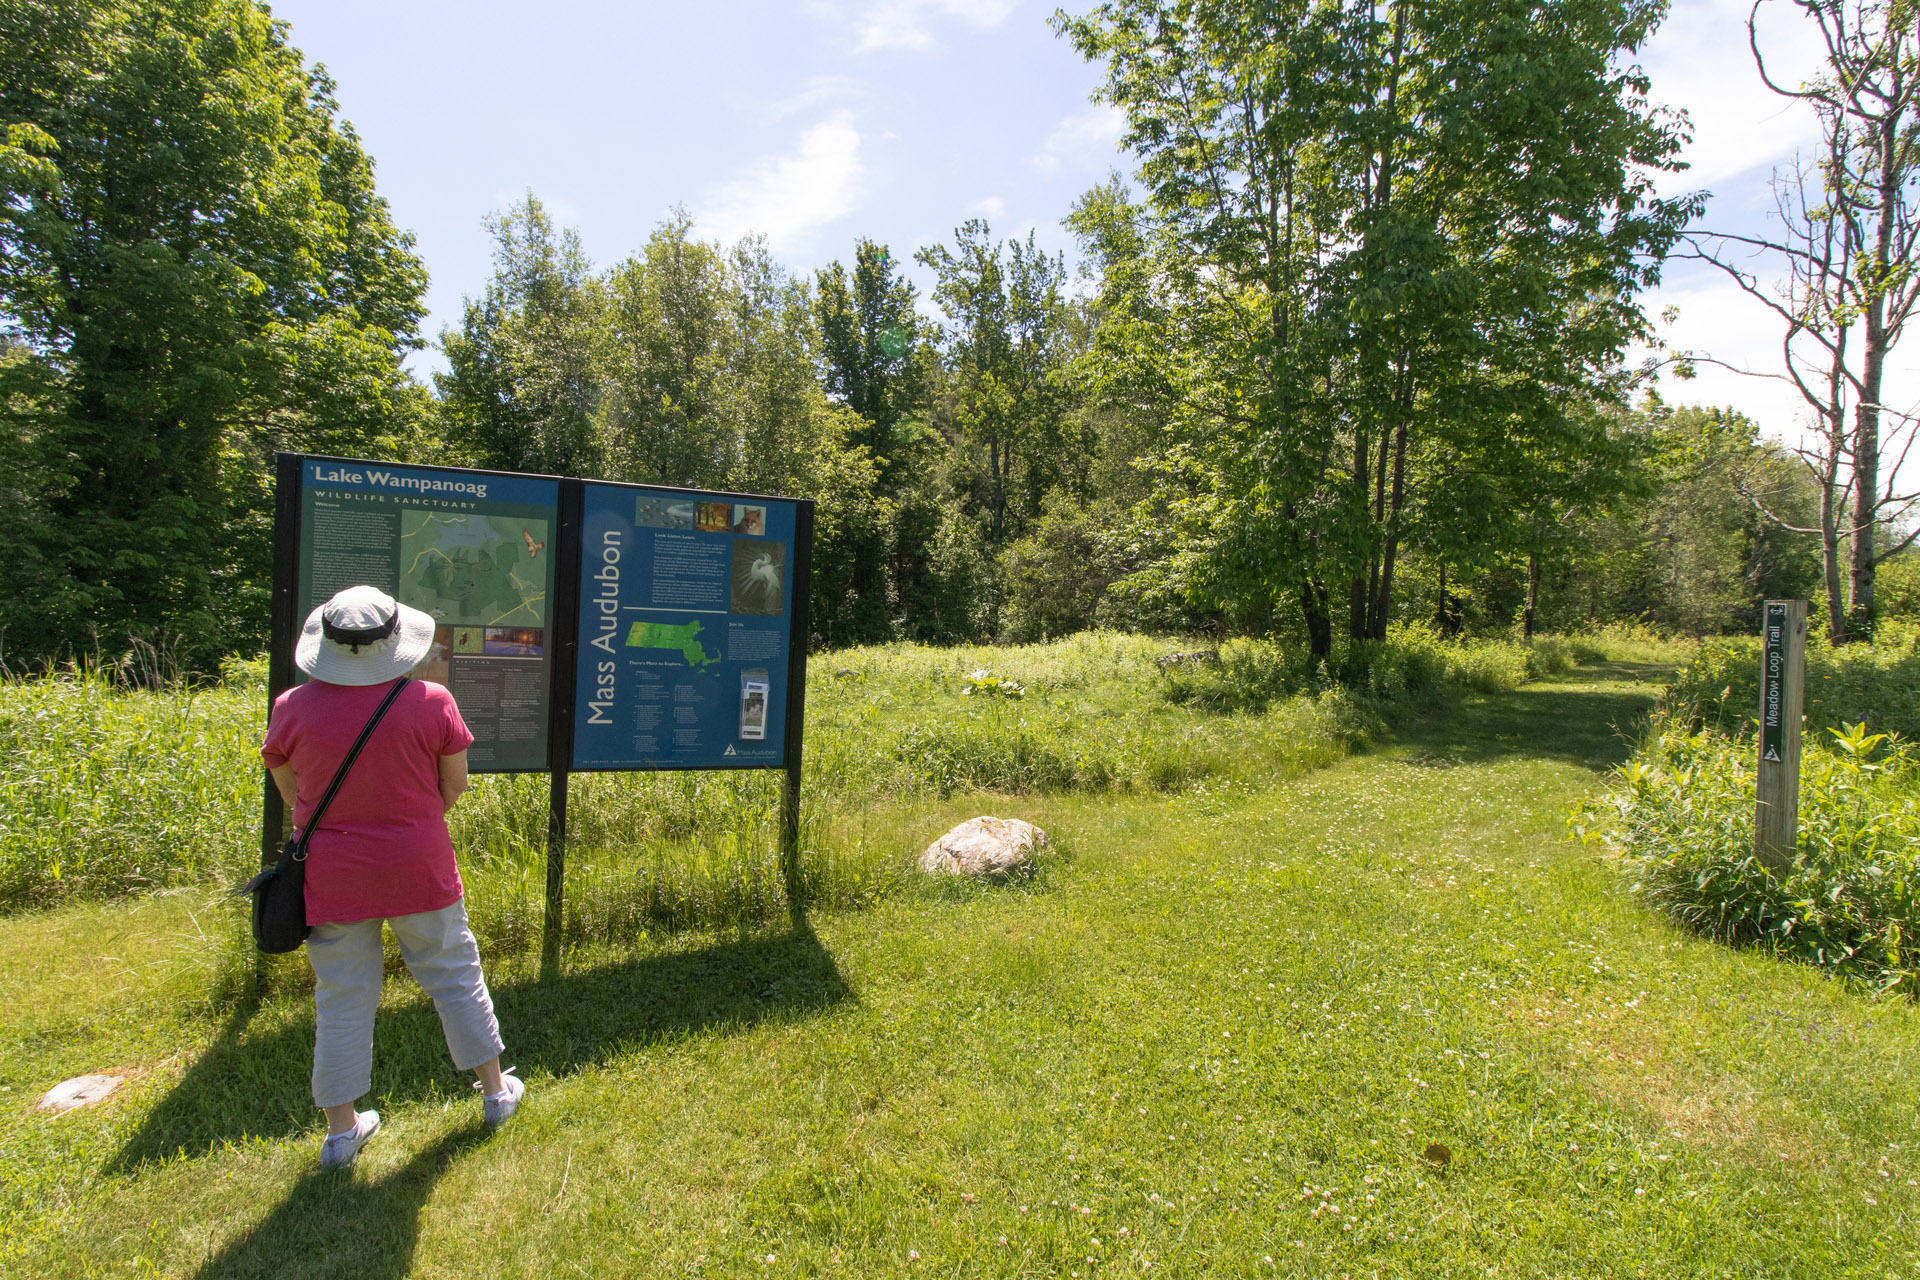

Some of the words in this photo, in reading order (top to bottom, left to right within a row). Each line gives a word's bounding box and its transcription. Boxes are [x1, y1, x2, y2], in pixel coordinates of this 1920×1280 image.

[315, 466, 363, 484] Lake
[366, 470, 488, 498] Wampanoag
[315, 490, 385, 502] WILDLIFE
[393, 496, 476, 509] SANCTUARY
[590, 531, 621, 654] Audubon
[1768, 626, 1781, 649] Trail
[1767, 651, 1783, 679] Loop
[587, 661, 616, 724] Mass
[1766, 681, 1780, 727] Meadow
